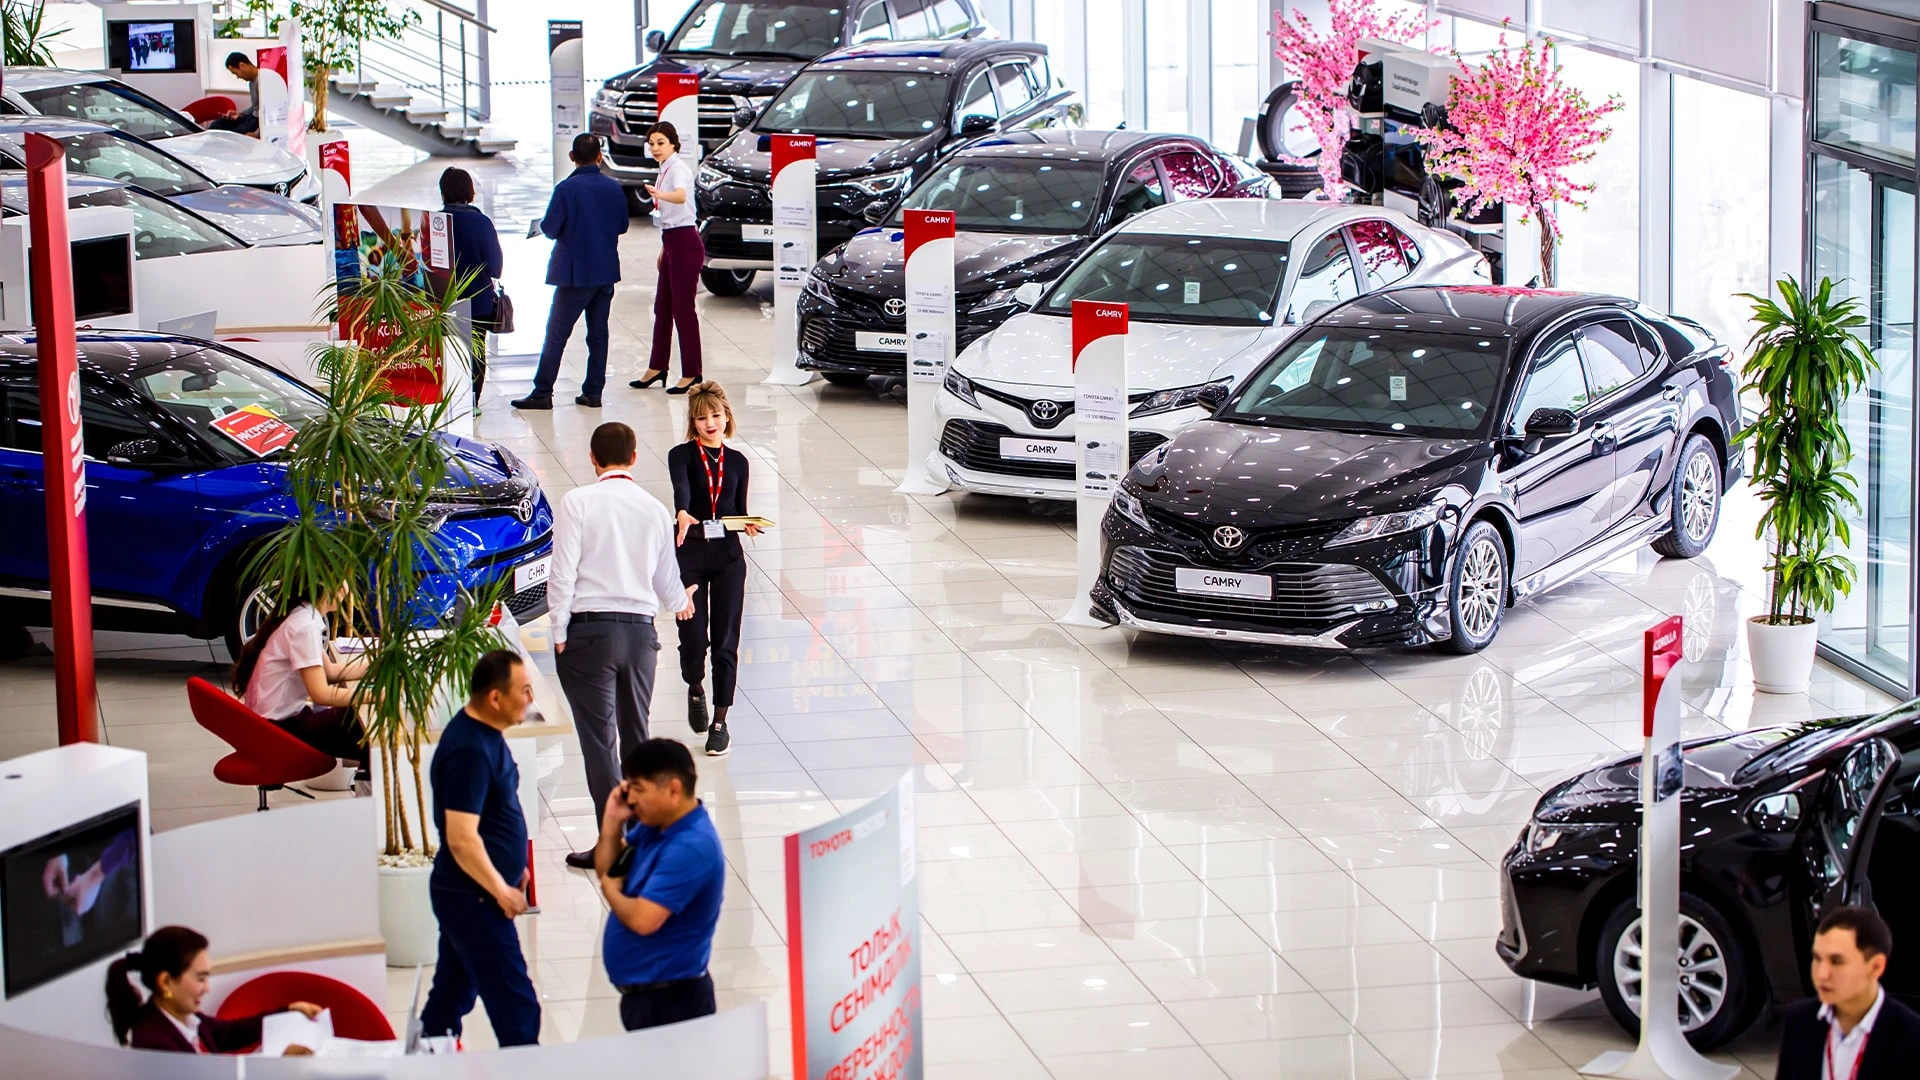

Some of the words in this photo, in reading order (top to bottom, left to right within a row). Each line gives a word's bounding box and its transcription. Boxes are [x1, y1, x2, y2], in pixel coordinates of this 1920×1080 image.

[924, 216, 950, 224] CAMRY
[1095, 309, 1123, 318] CAMRY
[878, 337, 906, 346] CAMRY
[1025, 444, 1058, 454] CAMRY
[528, 563, 545, 580] C-HR
[1203, 575, 1242, 588] CAMRY
[809, 829, 852, 859] TOYOTA
